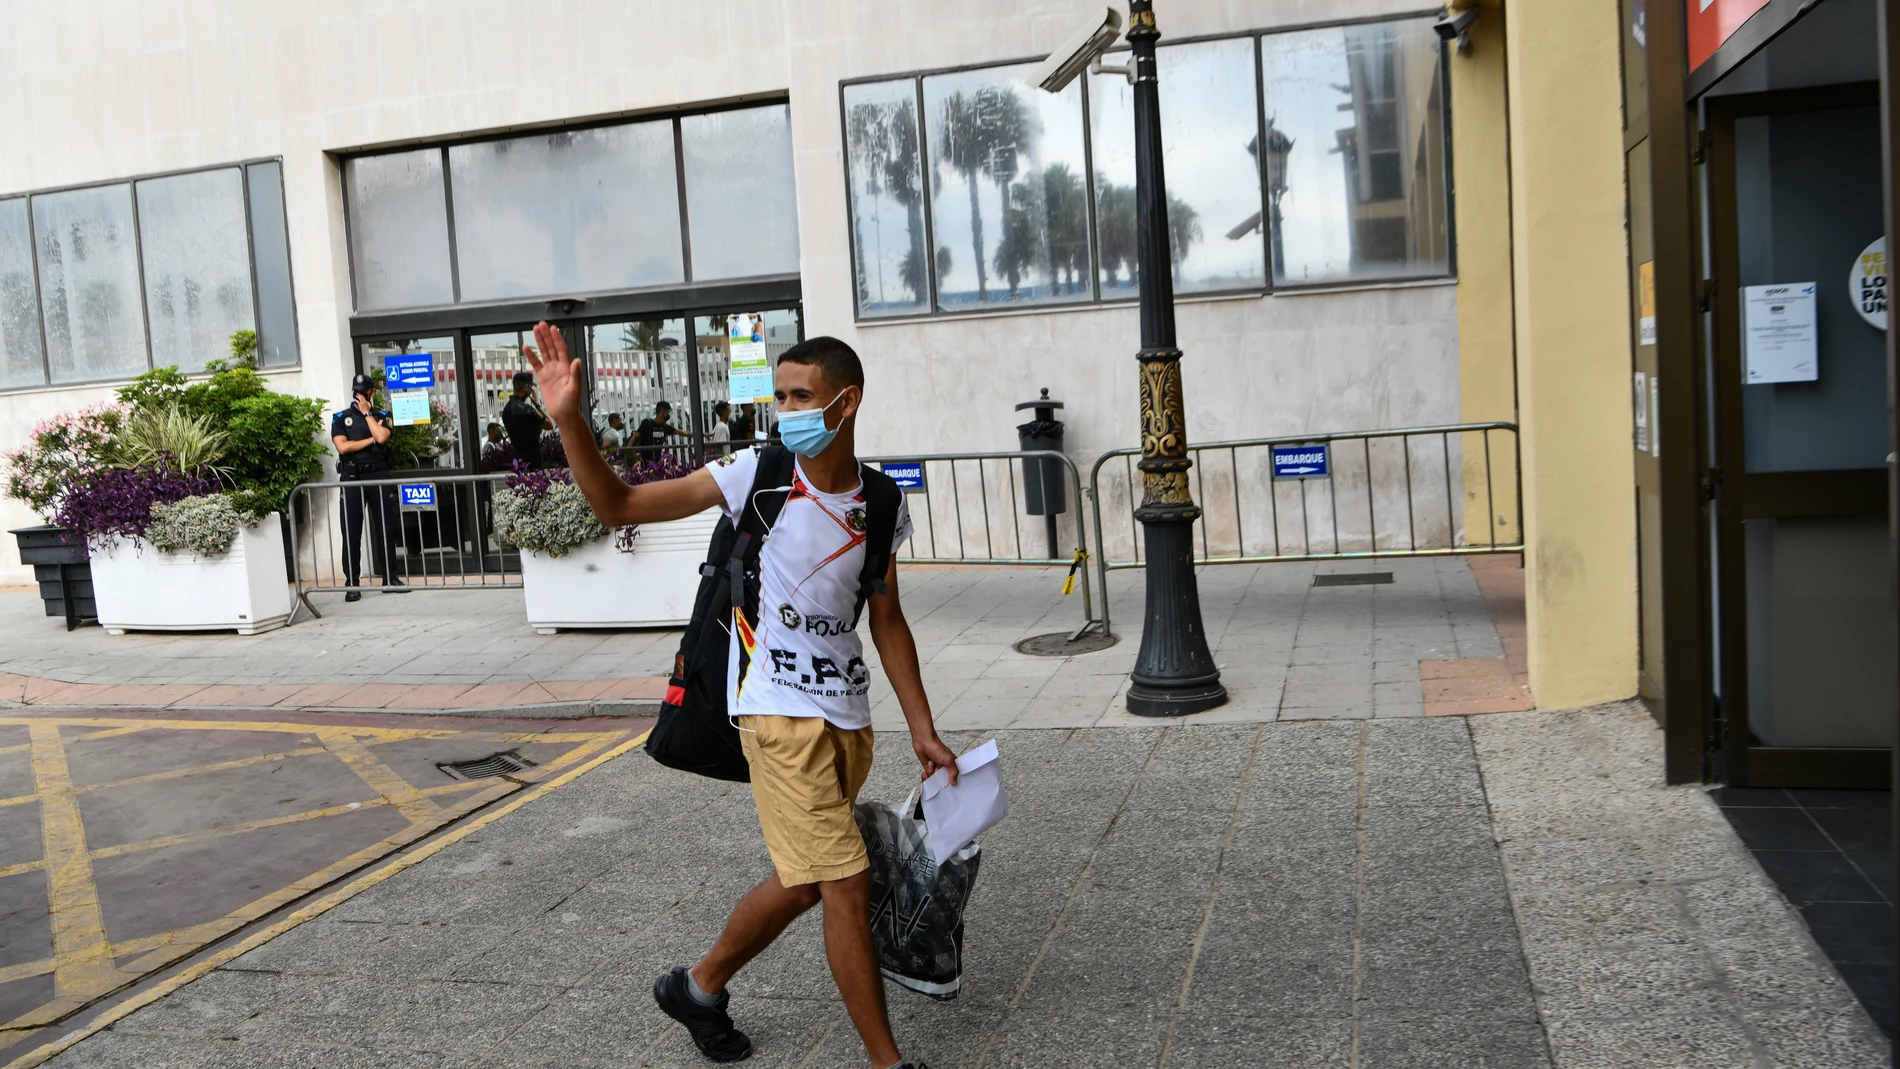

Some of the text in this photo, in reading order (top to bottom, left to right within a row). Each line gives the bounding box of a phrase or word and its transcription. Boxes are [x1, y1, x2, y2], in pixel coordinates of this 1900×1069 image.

[1862, 276, 1887, 289] LO
[1275, 453, 1325, 465] EMBARQUE
[405, 488, 431, 498] TAXI
[825, 689, 839, 697] DE
